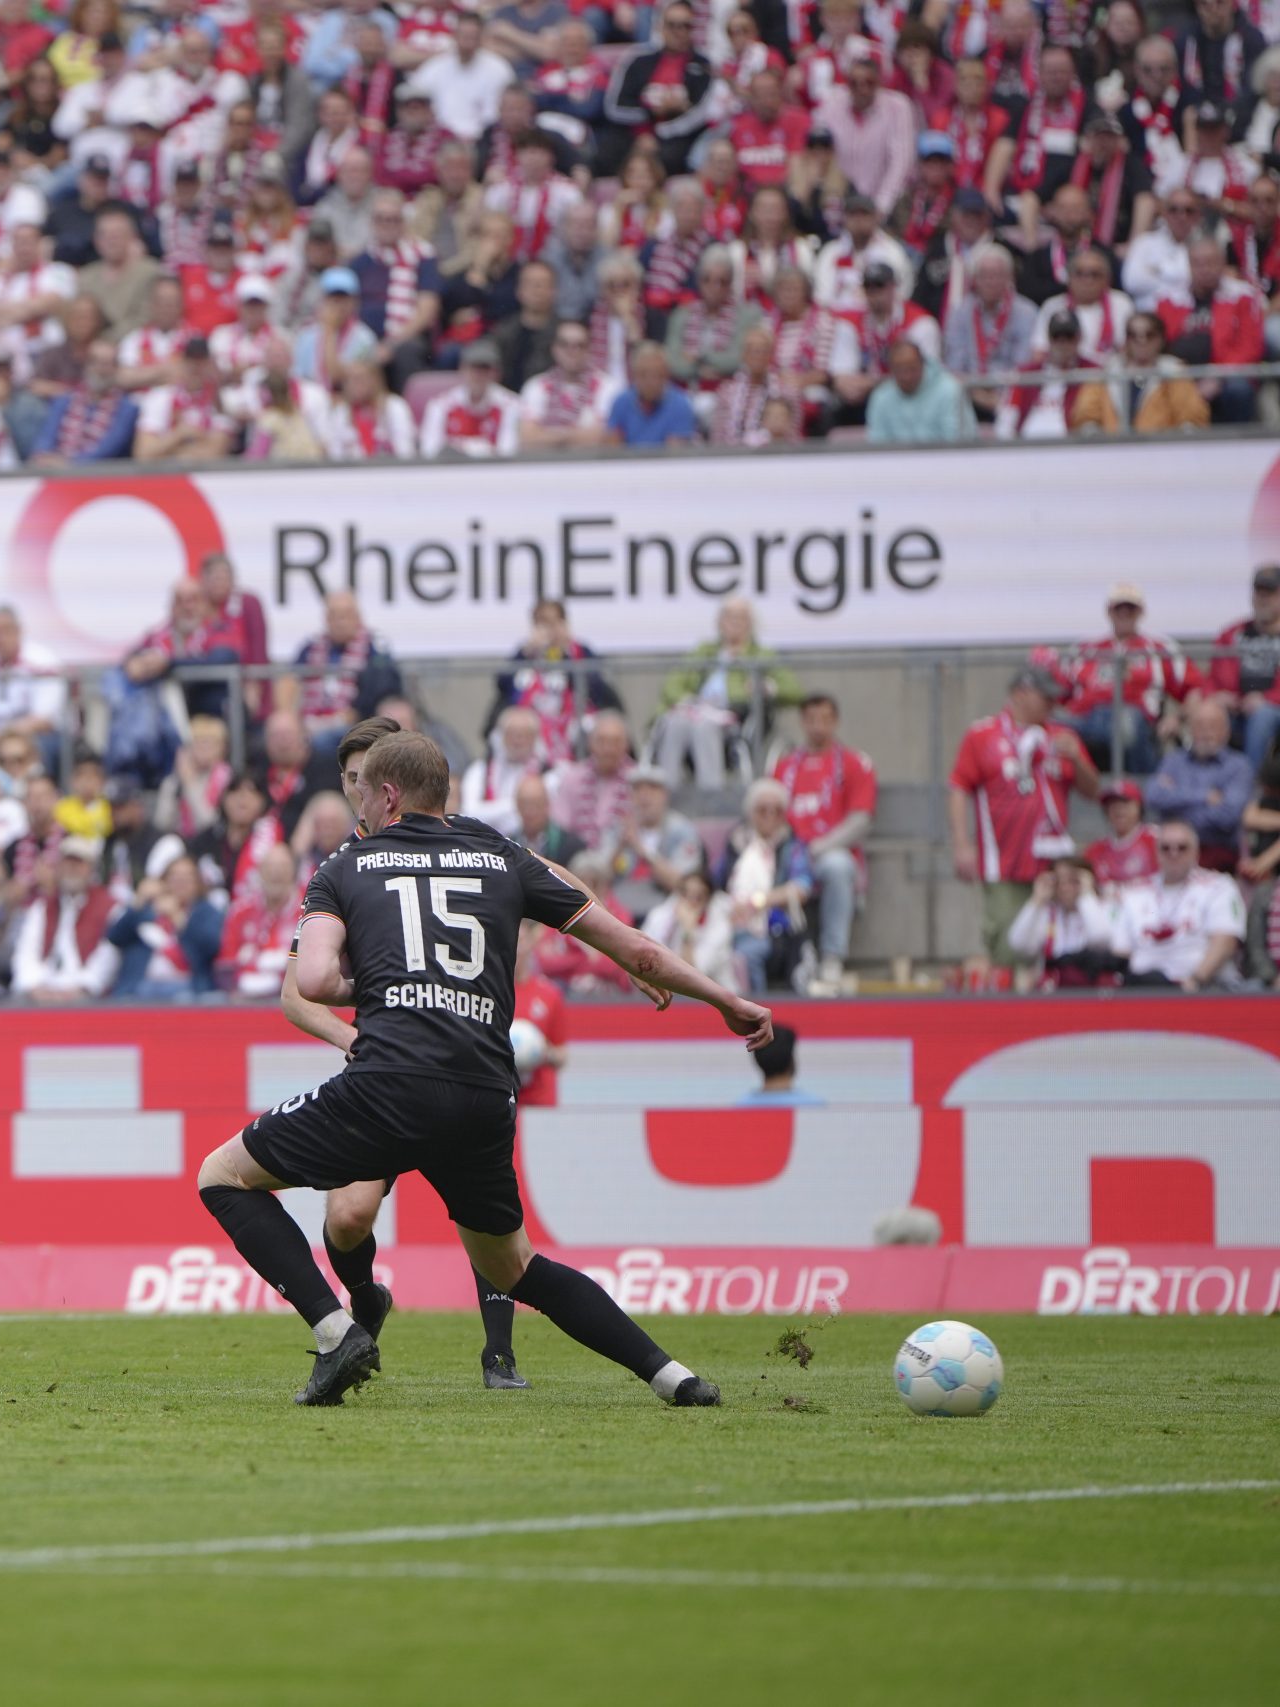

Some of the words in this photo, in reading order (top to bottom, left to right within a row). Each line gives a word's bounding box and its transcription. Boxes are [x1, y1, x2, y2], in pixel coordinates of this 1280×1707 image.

[275, 508, 942, 614] RheinEnergie
[356, 851, 432, 873] PREUSSEN
[439, 848, 508, 872] MÜNSTER
[385, 876, 485, 980] 15
[385, 983, 495, 1025] SCHERDER
